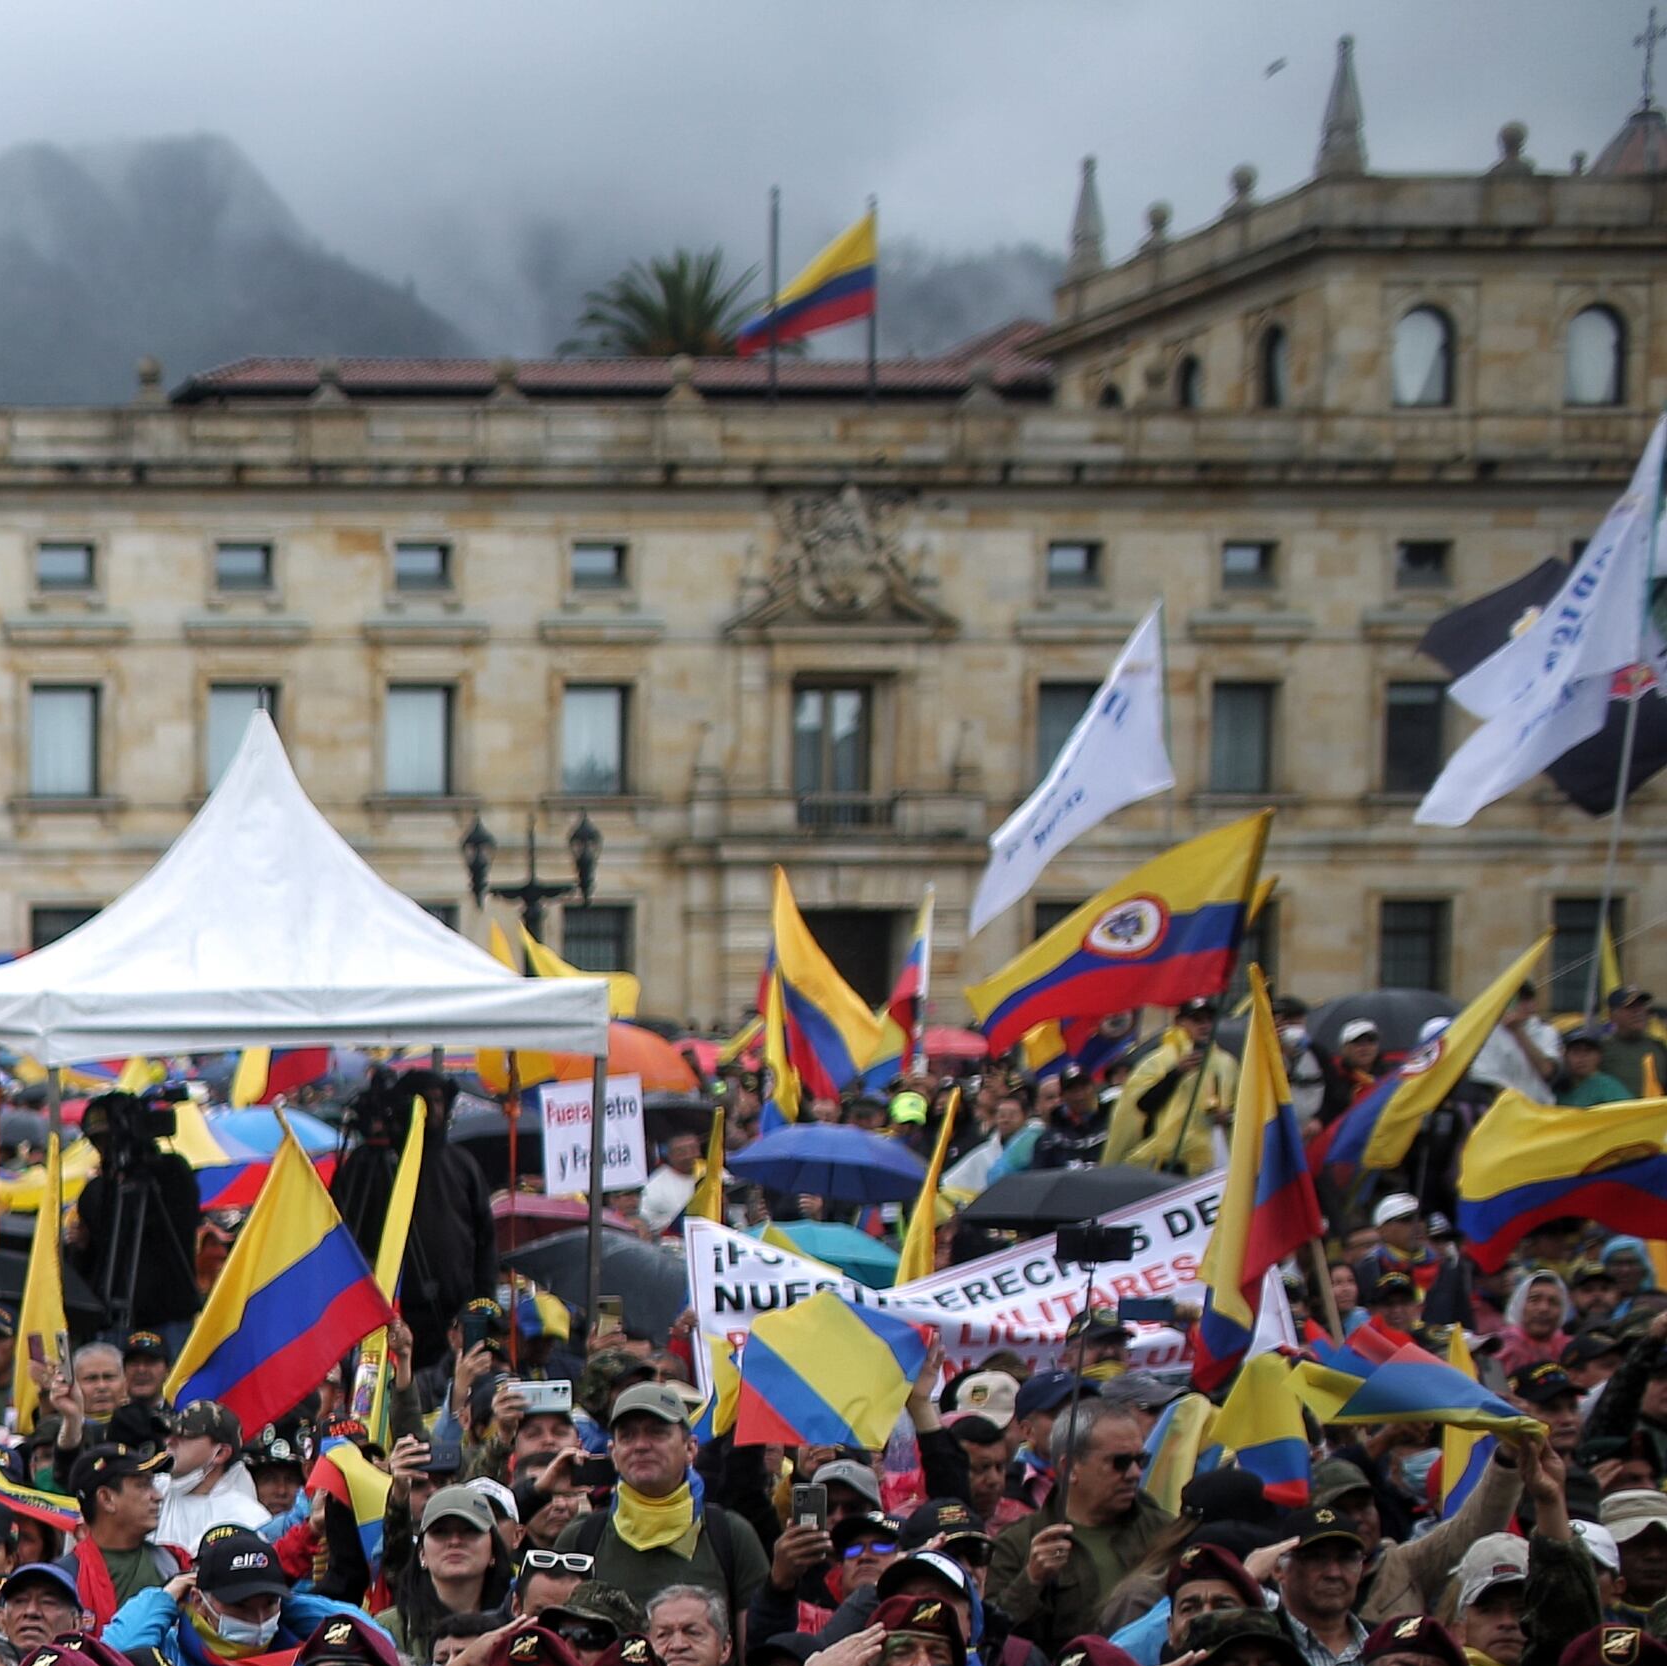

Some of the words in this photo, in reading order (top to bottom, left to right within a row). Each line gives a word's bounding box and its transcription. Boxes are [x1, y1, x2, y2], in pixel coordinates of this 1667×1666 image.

[548, 1099, 591, 1129] Fuera
[605, 1096, 638, 1120] etro
[558, 1152, 569, 1182] y
[1162, 1193, 1221, 1239] DE
[997, 1253, 1199, 1327] ILITARES
[232, 1552, 257, 1568] elf
